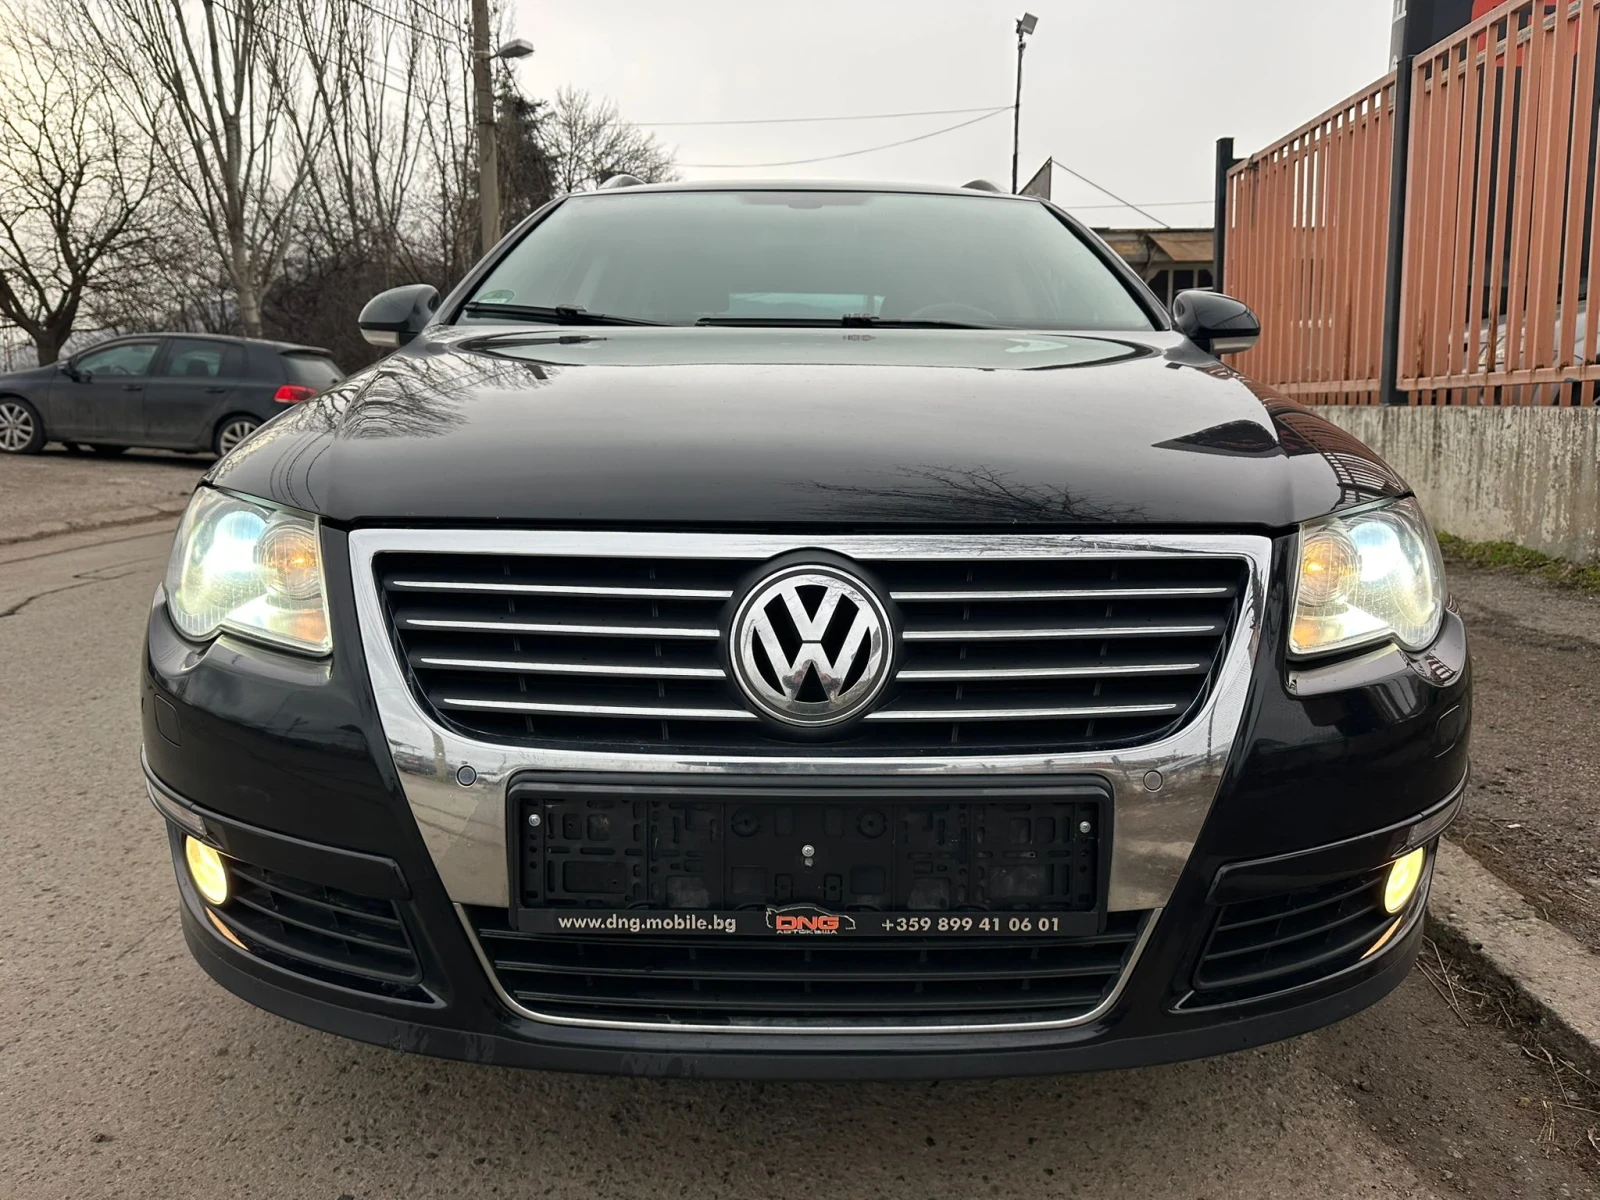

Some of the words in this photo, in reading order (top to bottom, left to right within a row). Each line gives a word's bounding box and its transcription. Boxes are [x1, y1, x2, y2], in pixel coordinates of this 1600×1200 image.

[558, 914, 736, 933] www.dng.mobile.bg
[776, 915, 840, 930] DNG
[881, 918, 931, 932] +359
[937, 917, 973, 932] 899
[978, 917, 1000, 932] 41
[1008, 917, 1032, 932] 06
[1038, 917, 1059, 932] 01
